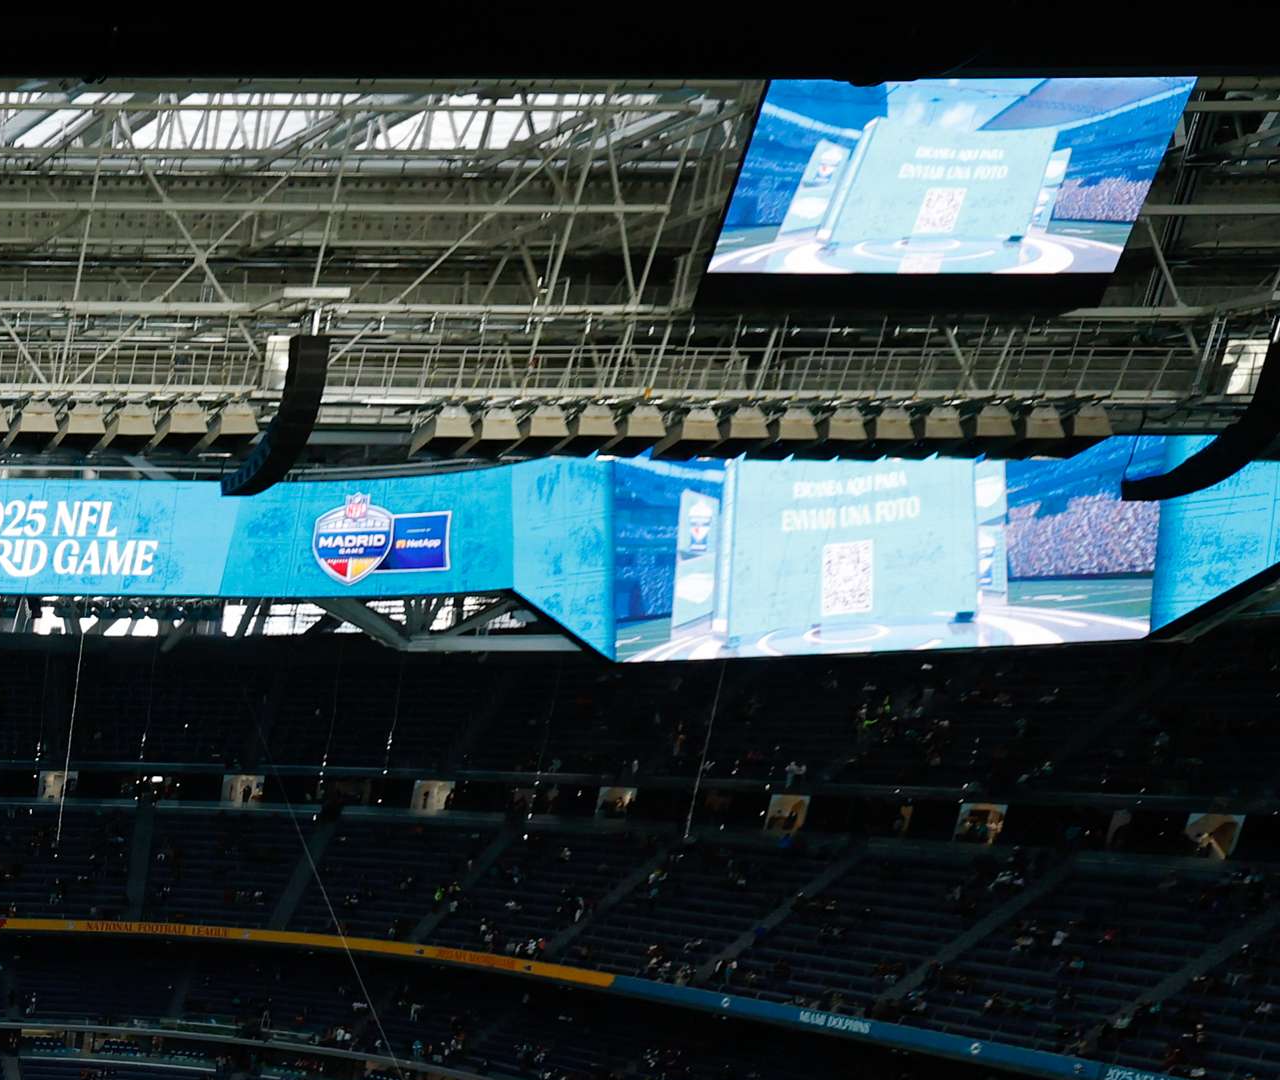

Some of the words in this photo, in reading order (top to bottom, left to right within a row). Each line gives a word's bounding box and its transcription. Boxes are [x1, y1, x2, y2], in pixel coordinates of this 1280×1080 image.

[52, 501, 117, 537] NFL
[781, 508, 836, 532] ENVIAR
[875, 496, 920, 522] FOTO
[53, 539, 159, 576] GAME
[318, 534, 386, 549] MADRID
